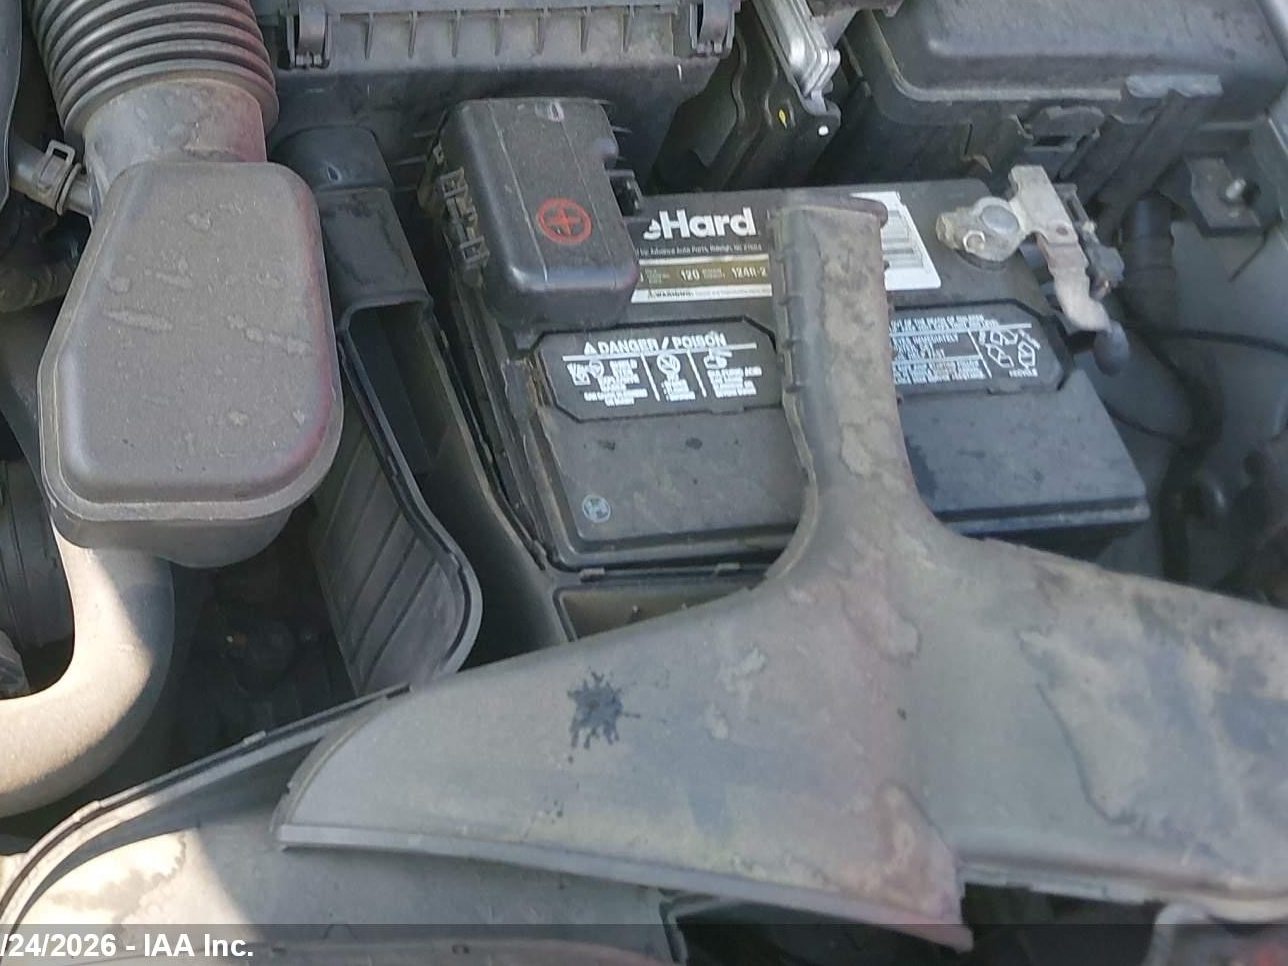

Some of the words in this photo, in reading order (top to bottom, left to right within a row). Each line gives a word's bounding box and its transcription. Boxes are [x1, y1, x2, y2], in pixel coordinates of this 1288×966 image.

[680, 268, 700, 282] 120
[597, 338, 659, 355] DANGER
[672, 333, 727, 350] POISON
